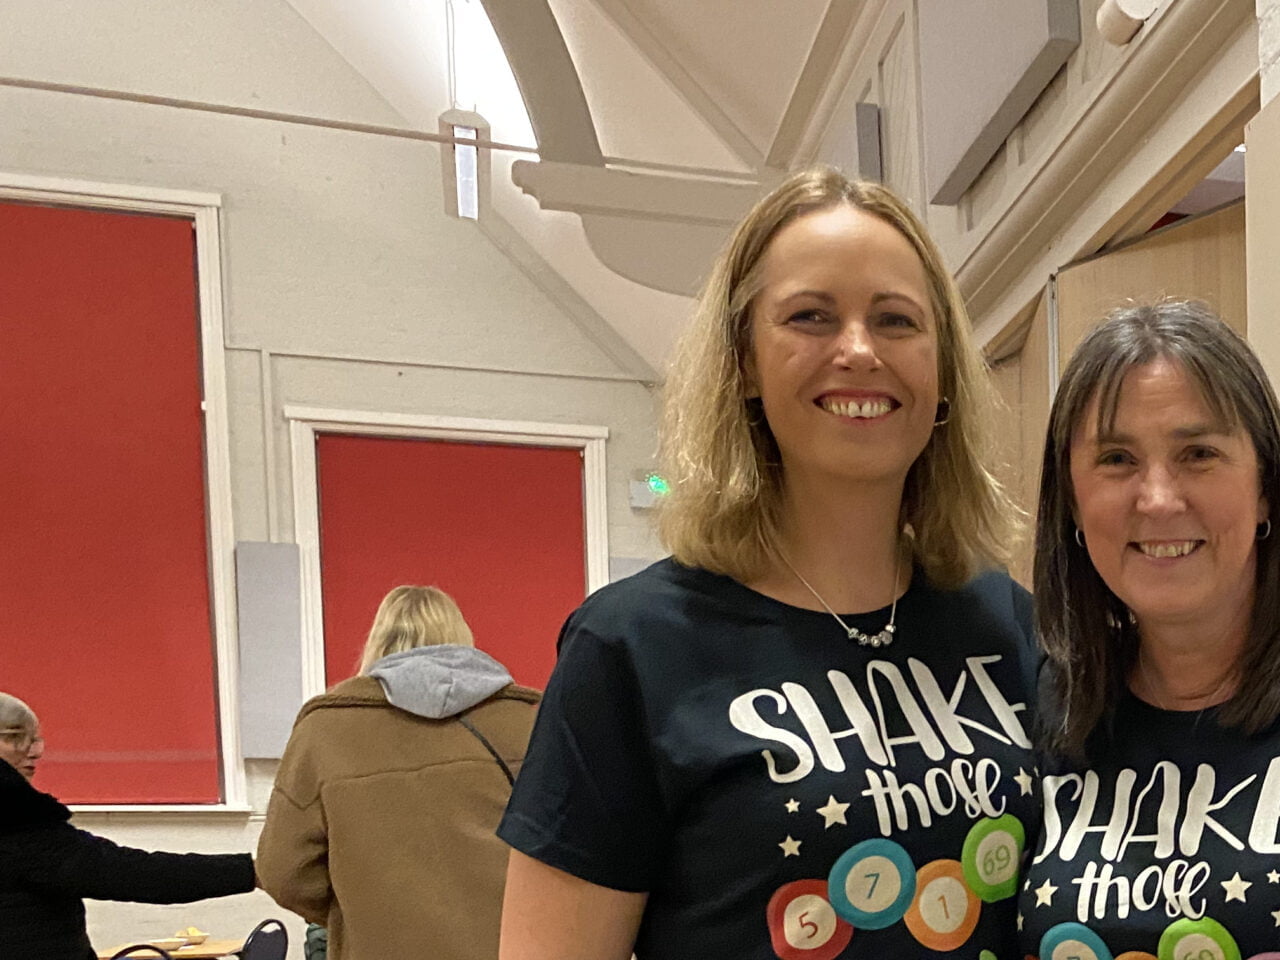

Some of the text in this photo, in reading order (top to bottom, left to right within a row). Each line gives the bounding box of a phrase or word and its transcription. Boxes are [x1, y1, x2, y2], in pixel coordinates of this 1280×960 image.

[729, 655, 1033, 784] SHAKE
[862, 757, 1008, 837] those
[798, 845, 1011, 940] 5 7 1 69
[1071, 860, 1211, 923] those
